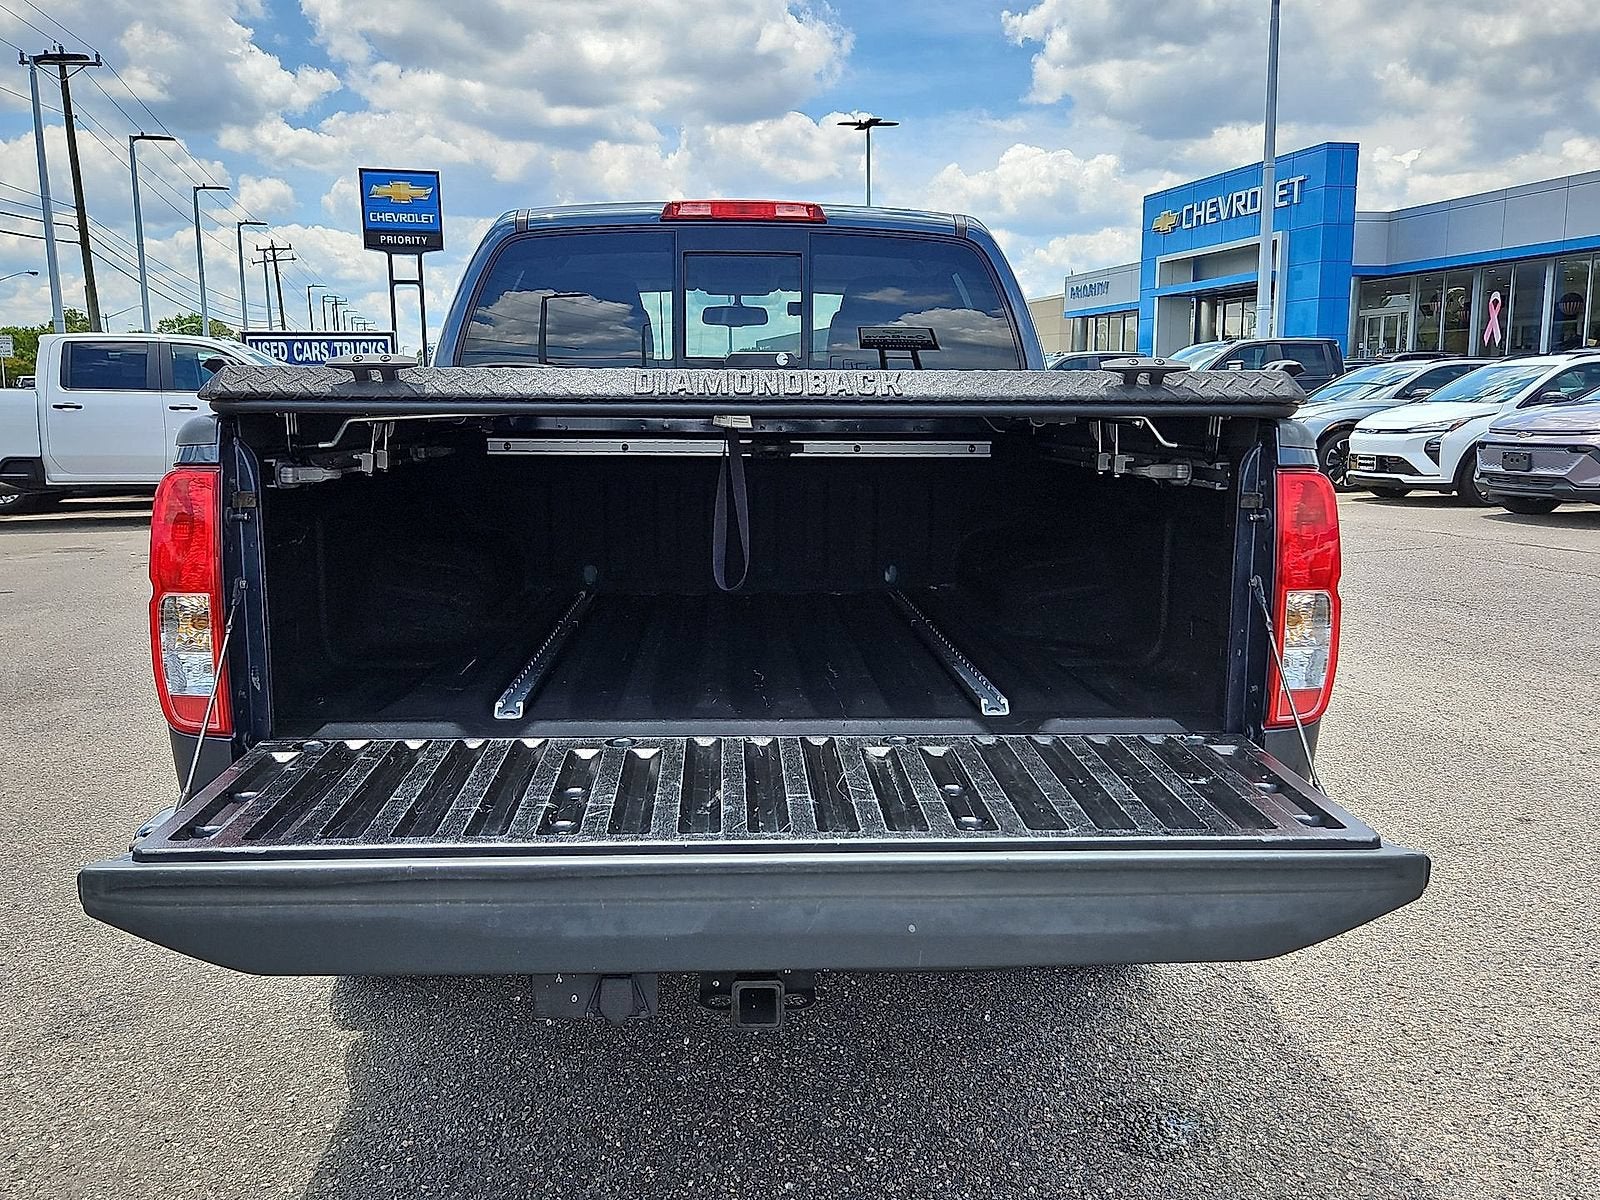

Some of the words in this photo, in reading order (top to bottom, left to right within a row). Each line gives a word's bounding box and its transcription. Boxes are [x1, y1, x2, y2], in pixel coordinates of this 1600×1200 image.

[1182, 175, 1307, 229] CHEVROET
[369, 212, 435, 223] CHEVROLET
[380, 235, 428, 245] PRIORITY
[634, 371, 903, 396] DIAMONDBACK
